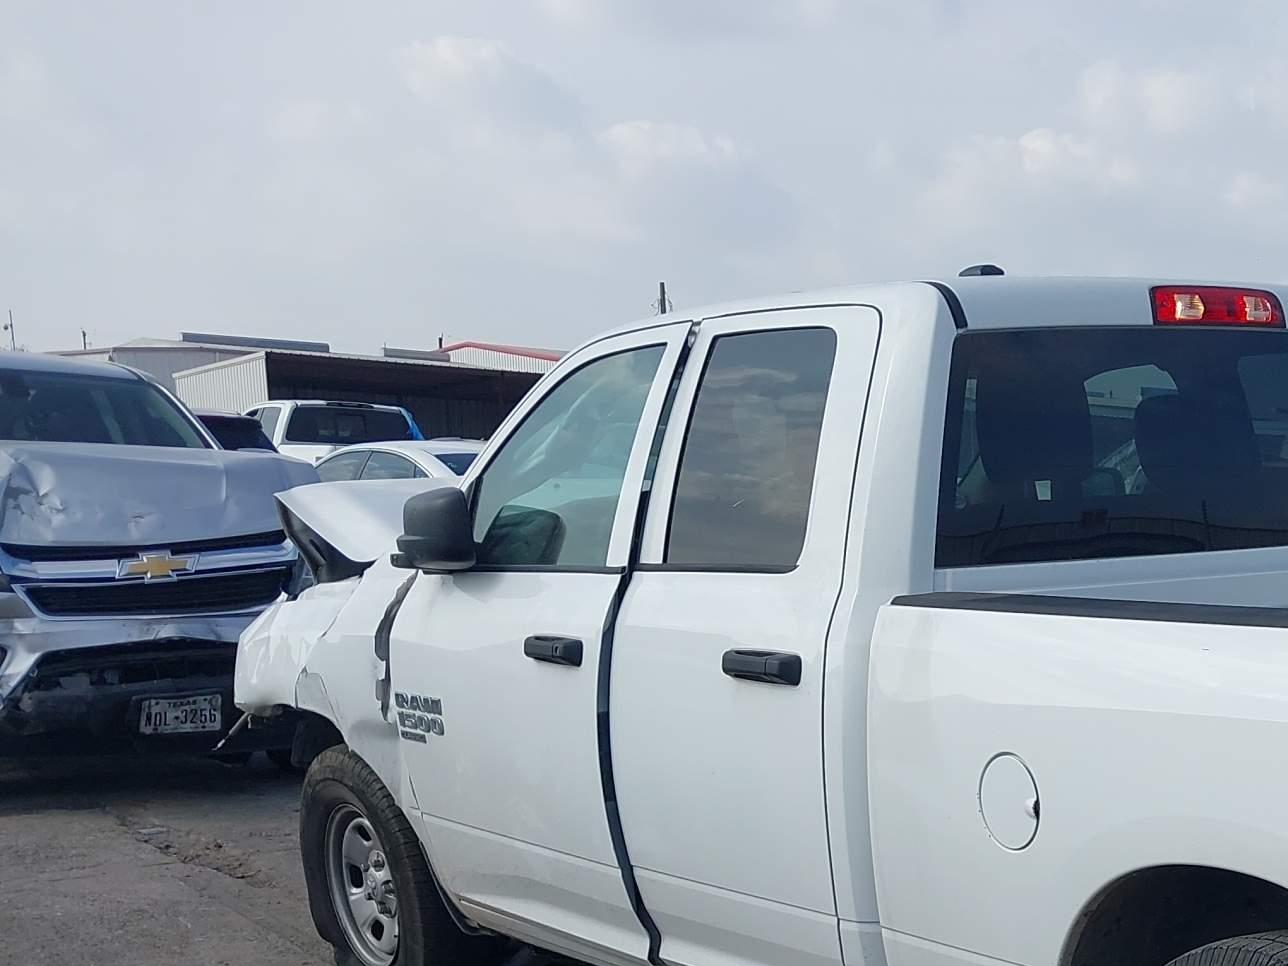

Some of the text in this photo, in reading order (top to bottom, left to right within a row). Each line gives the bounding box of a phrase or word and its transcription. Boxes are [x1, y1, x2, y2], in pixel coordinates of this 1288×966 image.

[167, 700, 198, 708] TEXAS
[395, 692, 443, 716] RAM
[397, 710, 445, 736] 1500
